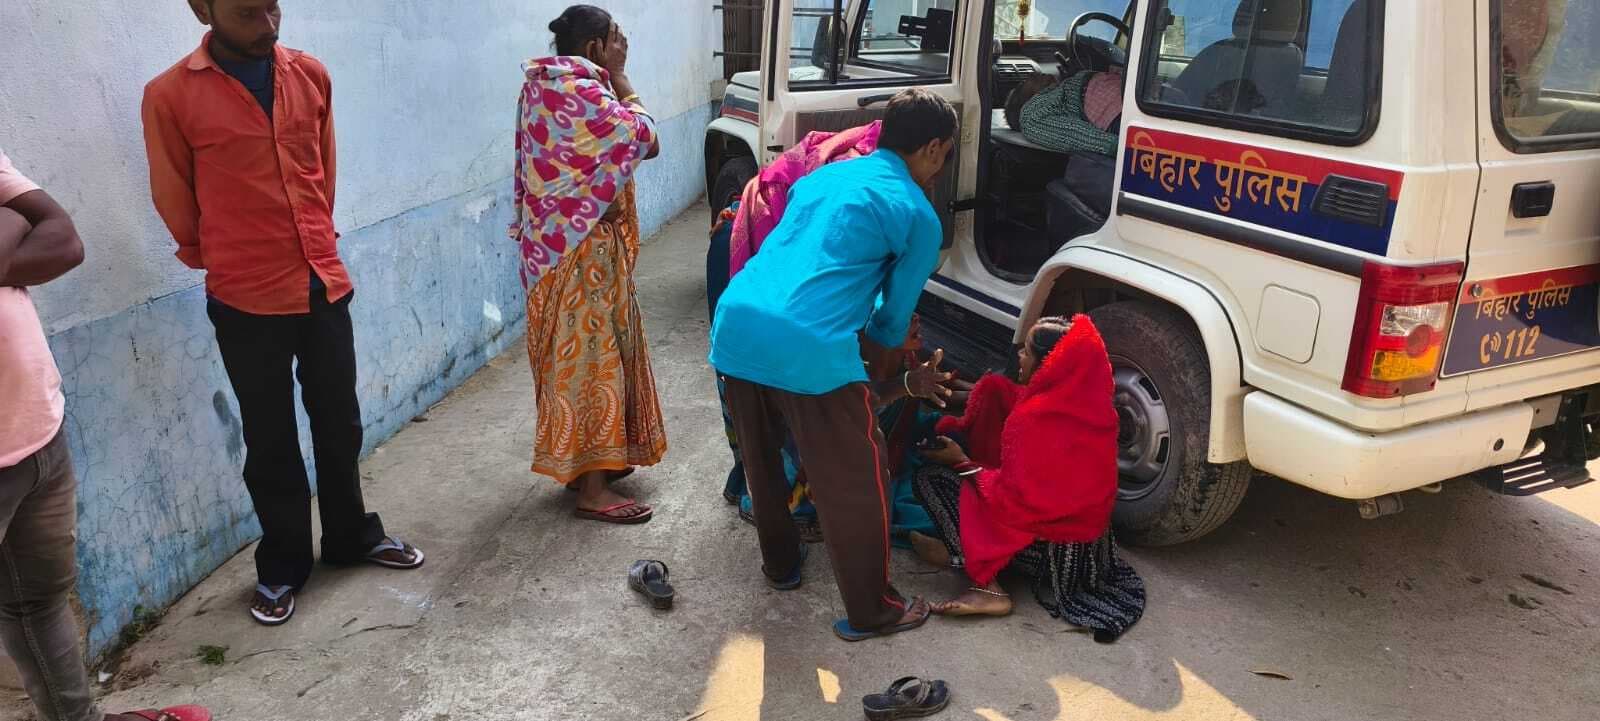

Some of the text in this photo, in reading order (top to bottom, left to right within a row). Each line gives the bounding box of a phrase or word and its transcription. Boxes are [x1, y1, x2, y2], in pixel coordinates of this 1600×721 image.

[1130, 131, 1308, 213] बिहार पुलिस
[1475, 278, 1574, 320] बिहार पुलिस
[1504, 325, 1541, 359] 112
